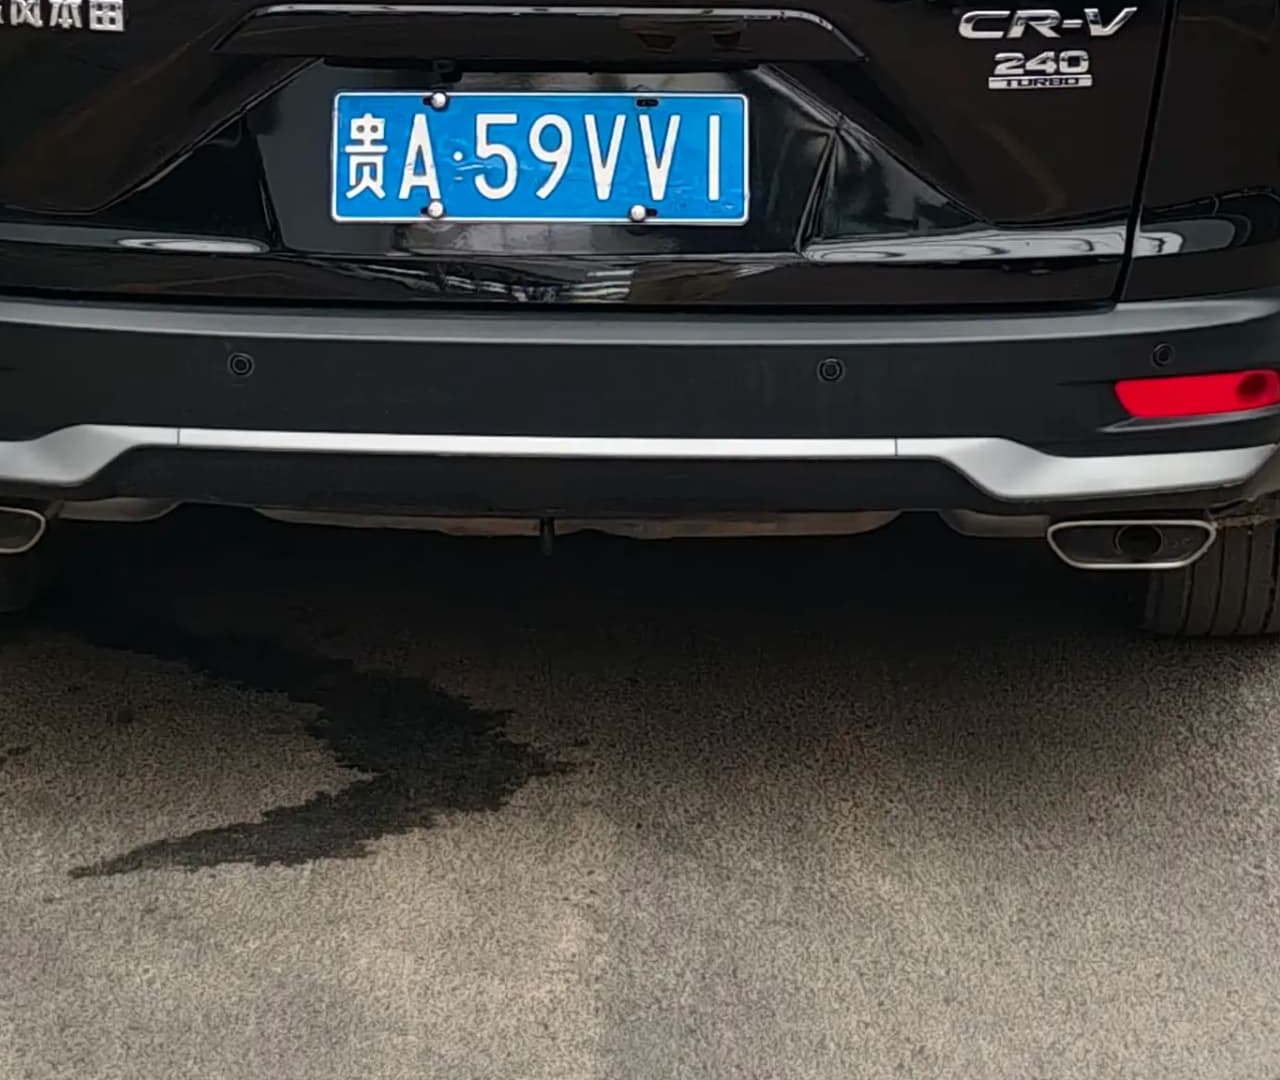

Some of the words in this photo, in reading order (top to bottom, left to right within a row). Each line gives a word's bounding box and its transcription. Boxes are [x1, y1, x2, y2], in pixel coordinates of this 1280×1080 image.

[958, 6, 1138, 39] CR-V
[994, 50, 1089, 75] 240
[1005, 76, 1080, 88] TURBO
